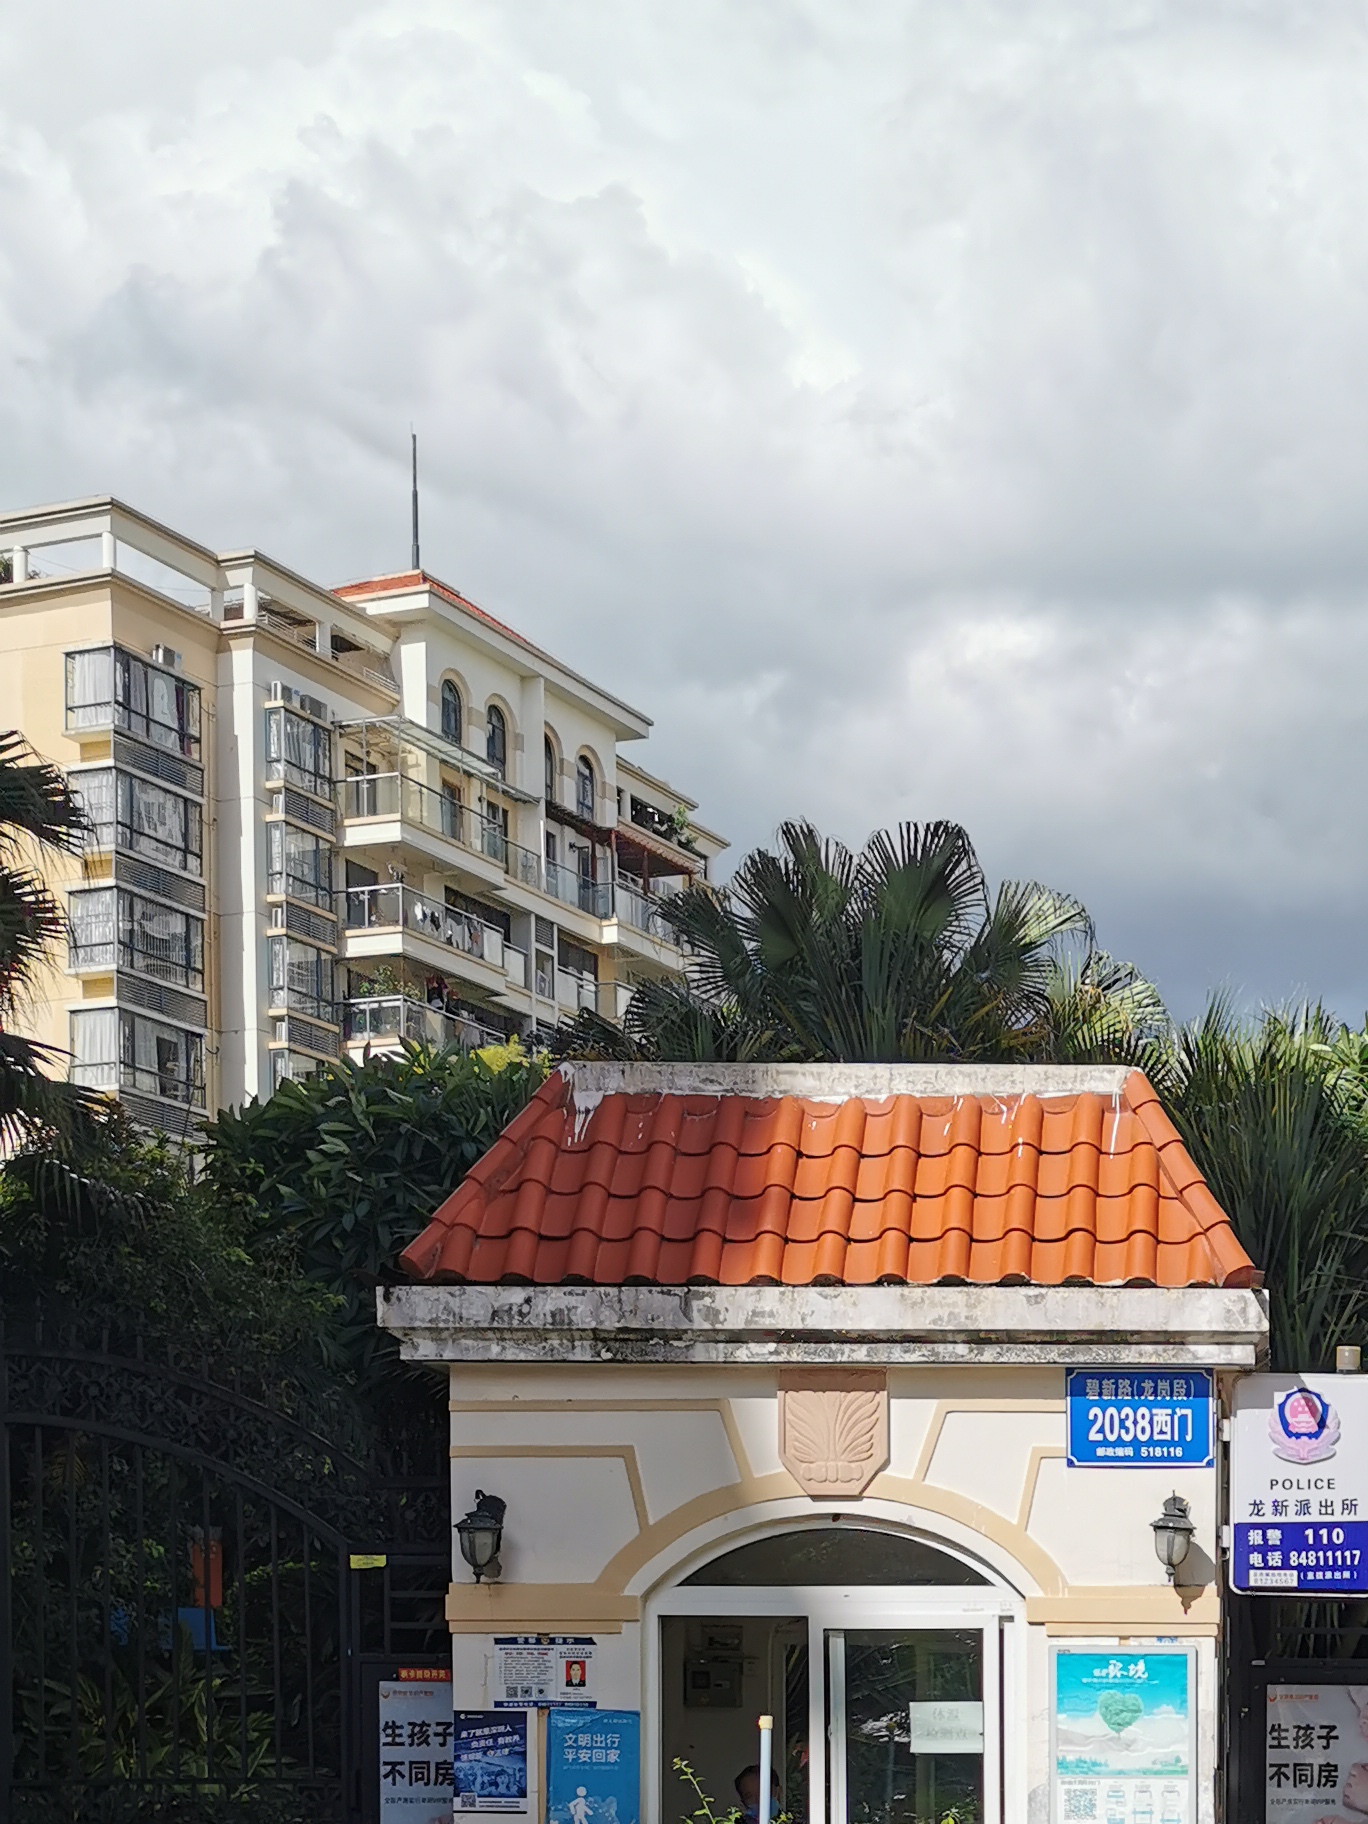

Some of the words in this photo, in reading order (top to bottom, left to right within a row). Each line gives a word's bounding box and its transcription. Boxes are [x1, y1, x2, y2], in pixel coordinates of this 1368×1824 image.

[1088, 1407, 1192, 1442] 2038西门
[1141, 1447, 1183, 1457] 518116
[1270, 1478, 1336, 1490] POLICE
[1248, 1498, 1359, 1517] 龙新派出所
[1247, 1528, 1282, 1546] 报警
[1304, 1528, 1345, 1545] 110
[1249, 1551, 1283, 1568] 电话
[1289, 1550, 1361, 1567] 84811117
[382, 1720, 454, 1747] 生孩子
[563, 1733, 620, 1747] 文明出行
[1268, 1723, 1339, 1750] 生孩子
[563, 1749, 620, 1763] 平安回家
[382, 1760, 454, 1787] 不同房
[1268, 1762, 1339, 1788] 不同房
